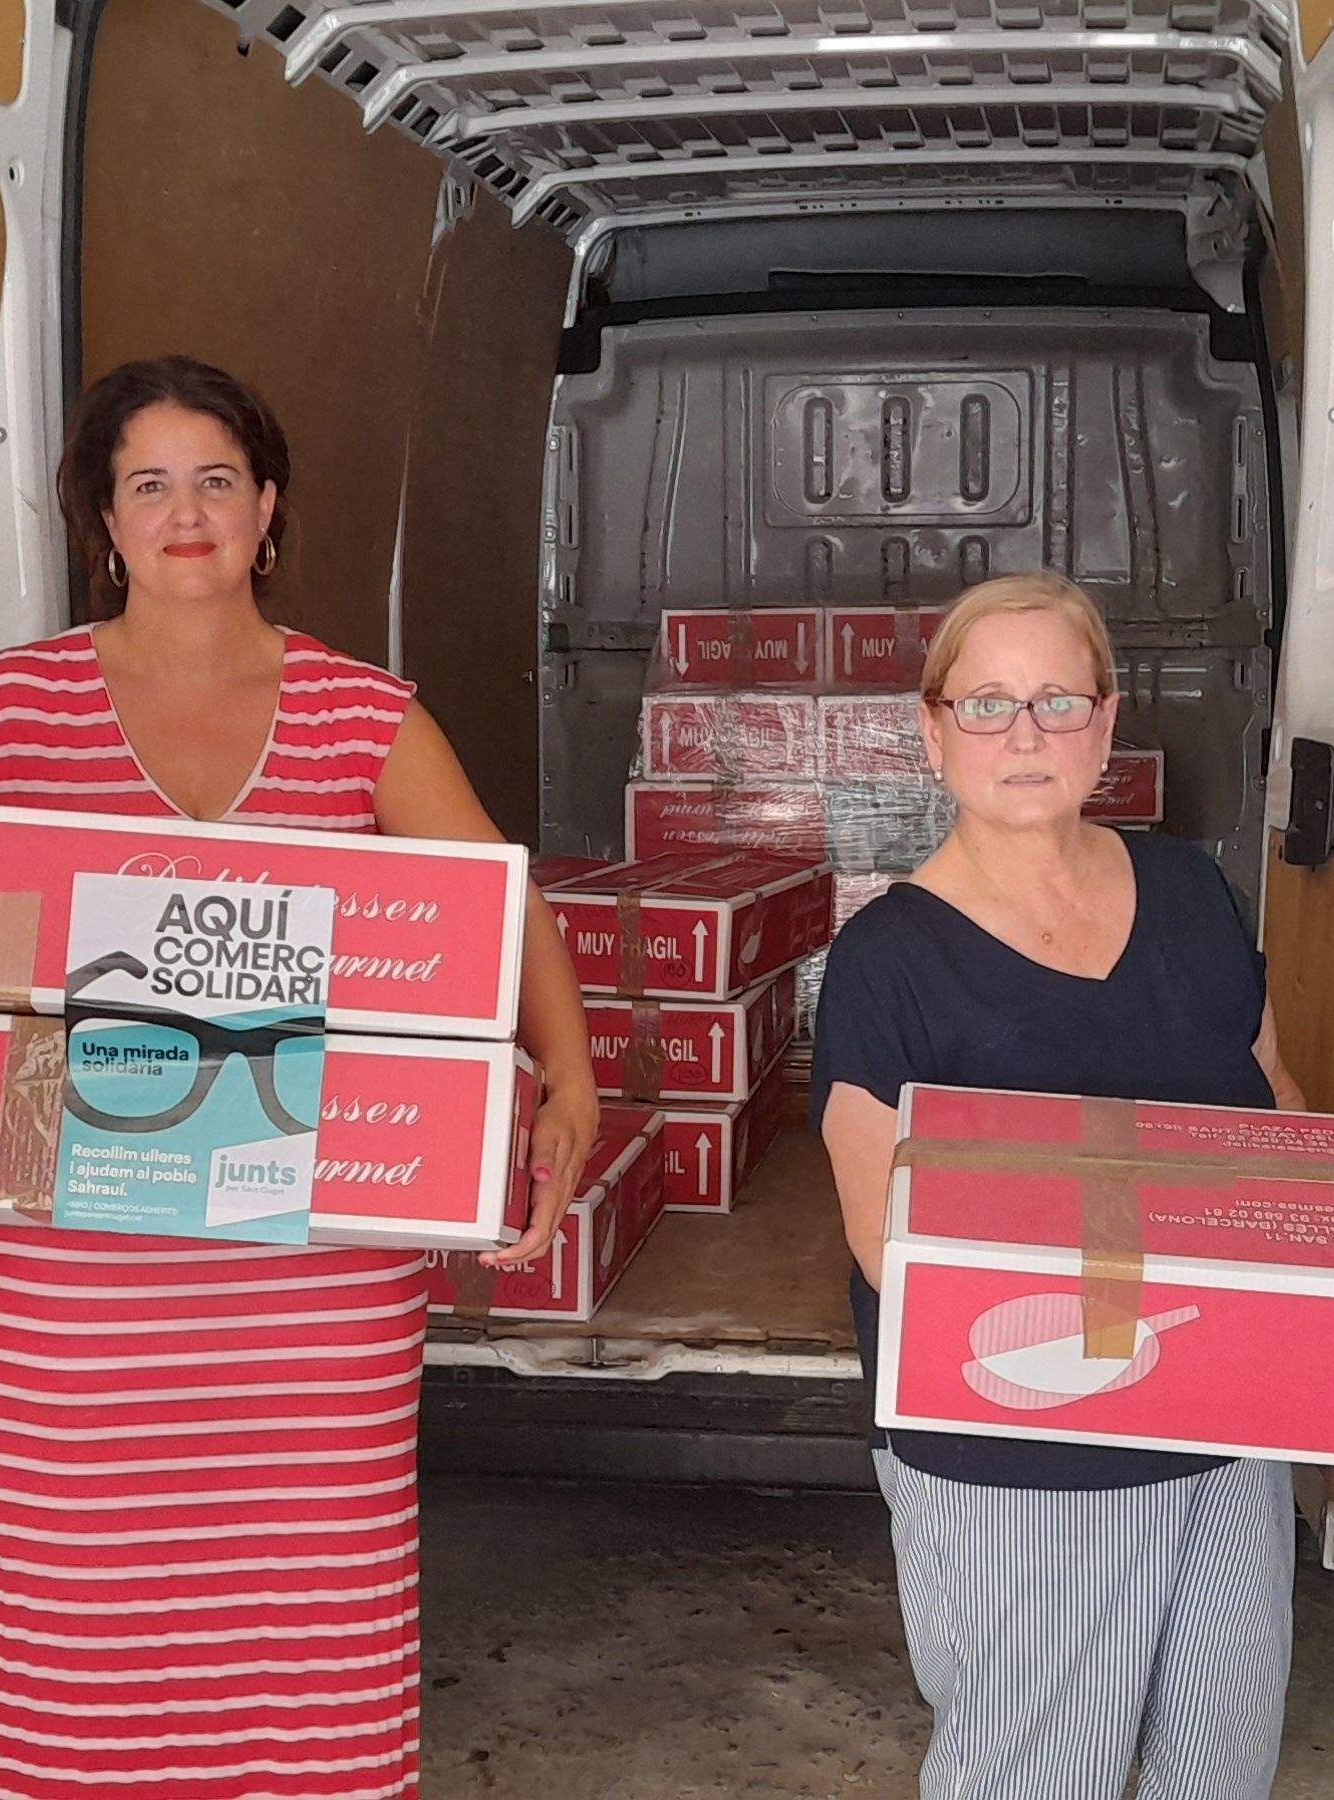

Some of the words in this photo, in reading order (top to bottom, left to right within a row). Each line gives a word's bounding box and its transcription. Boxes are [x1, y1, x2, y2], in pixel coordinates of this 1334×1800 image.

[697, 640, 732, 660] AGIL
[754, 639, 788, 659] MUY
[862, 638, 895, 658] MUY
[155, 889, 292, 942] AQUÍ
[577, 931, 615, 956] MUY
[153, 935, 324, 984] COMERÇ
[150, 967, 322, 1005] SOLIDARI
[82, 1042, 119, 1057] Una
[124, 1044, 189, 1062] mirada
[590, 1036, 629, 1060] MUY
[71, 1143, 138, 1162] Recollim
[141, 1147, 192, 1165] ulleres
[70, 1163, 75, 1174] i
[78, 1162, 134, 1180] ajudem
[136, 1167, 150, 1180] al
[152, 1168, 197, 1184] poble
[215, 1154, 297, 1188] junts
[314, 1154, 424, 1186] urmet
[1148, 1211, 1278, 1231] (BARCELONA)
[1228, 1209, 1248, 1219] 02
